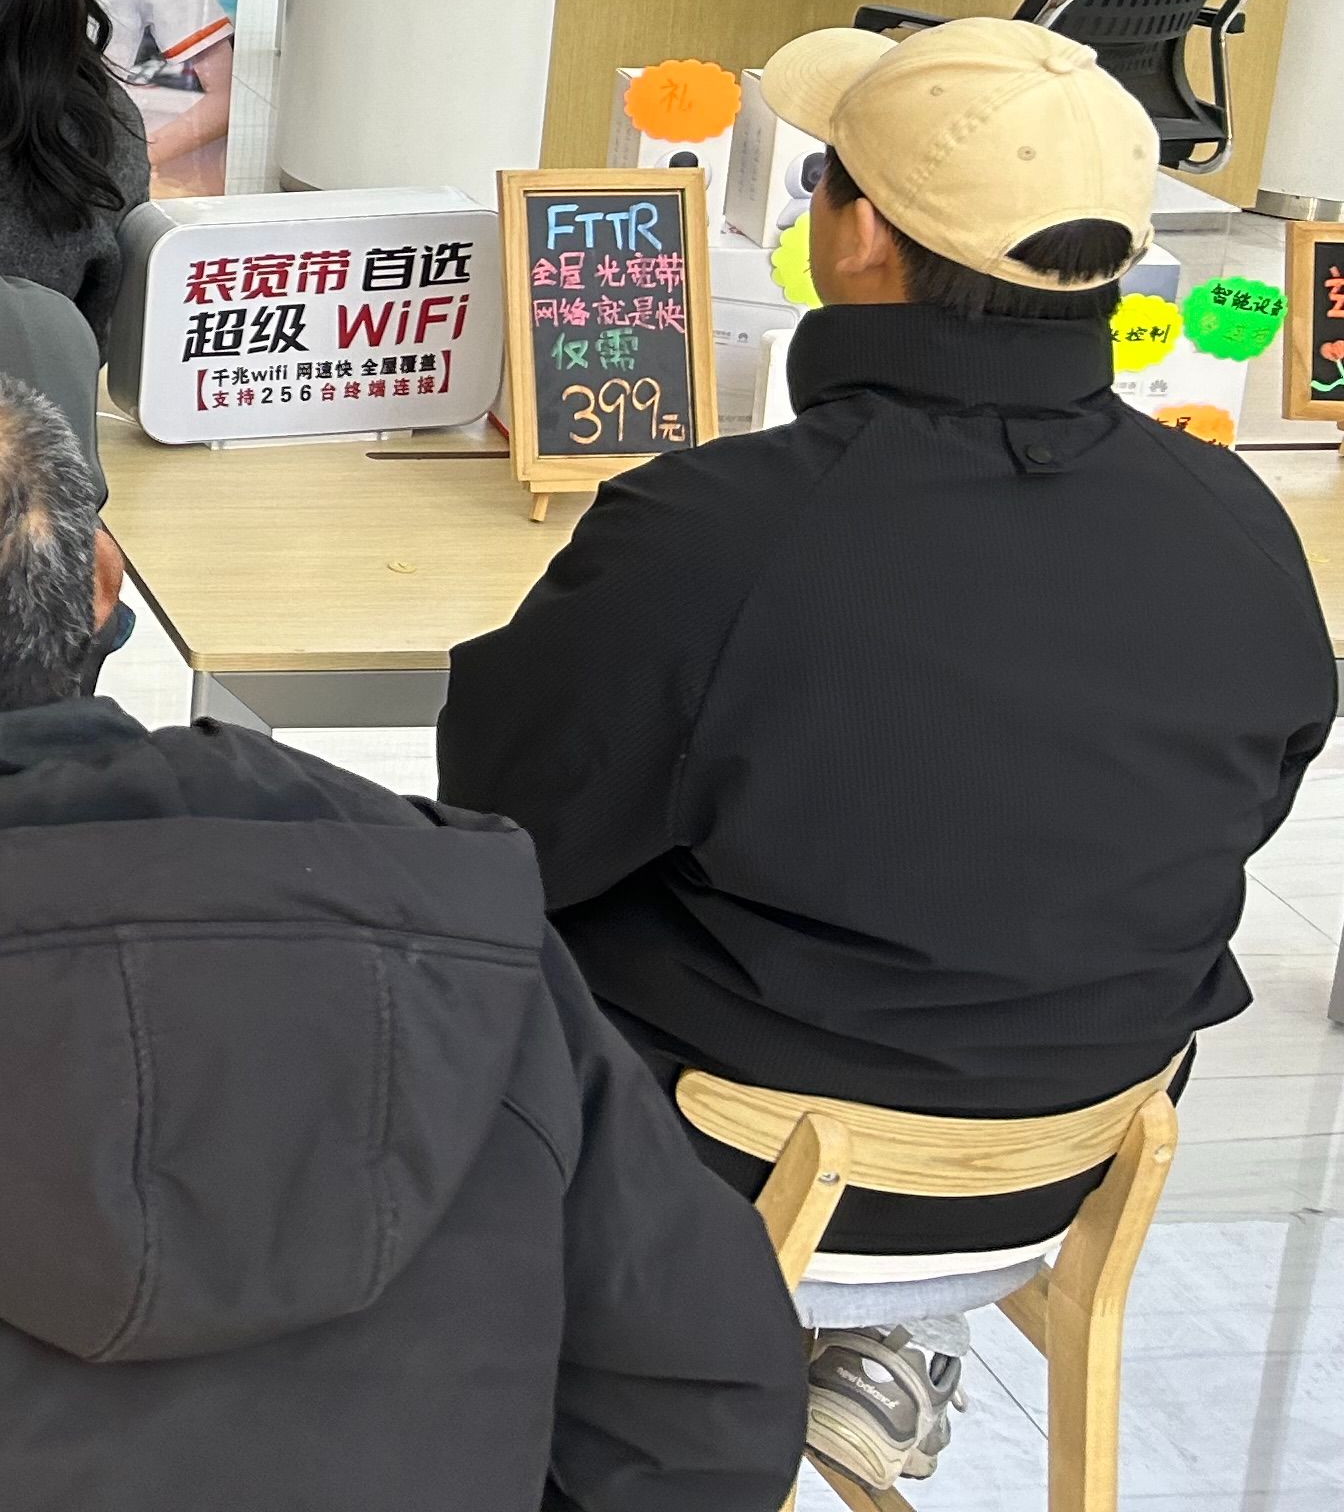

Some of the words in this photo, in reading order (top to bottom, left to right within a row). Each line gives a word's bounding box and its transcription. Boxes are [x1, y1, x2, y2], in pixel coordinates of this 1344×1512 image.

[660, 78, 693, 113] 礼
[546, 201, 663, 251] FTTR
[362, 241, 474, 293] 首选
[1210, 283, 1284, 317] 智能设备
[181, 303, 310, 363] 超级
[336, 293, 471, 350] WiFi
[551, 328, 639, 371] 仅需
[295, 359, 353, 382] 网速快
[360, 354, 437, 378] 全屋覆盖
